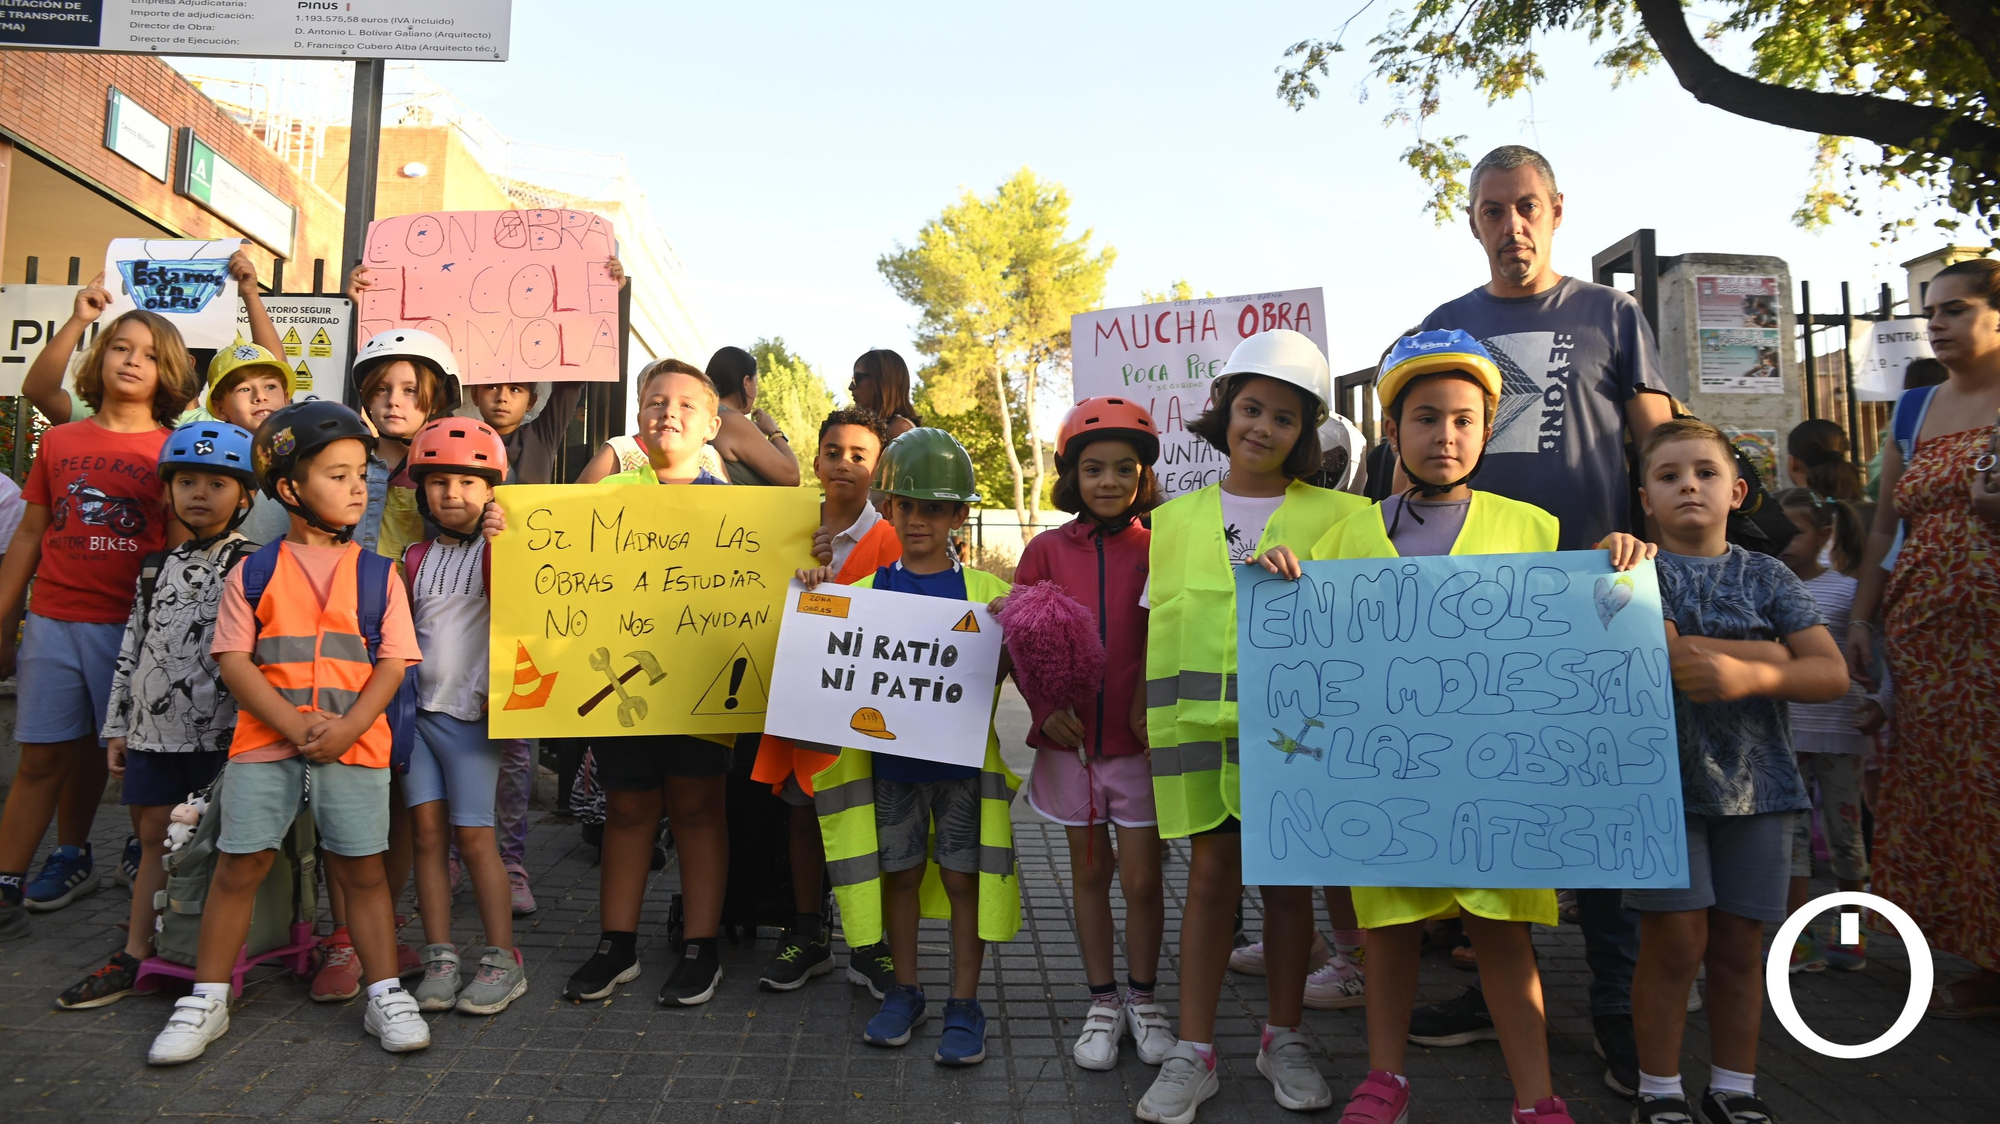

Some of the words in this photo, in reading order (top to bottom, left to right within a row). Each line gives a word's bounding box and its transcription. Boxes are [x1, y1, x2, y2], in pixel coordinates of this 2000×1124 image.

[0, 0, 62, 9] ILITACIÓN
[130, 9, 170, 17] Importe
[187, 11, 255, 19] adjudicación:
[8, 11, 93, 23] TRANSPORTE,
[129, 22, 170, 30] Director
[295, 15, 359, 23] 1.193.575,58
[390, 17, 410, 25] (IVA
[412, 18, 454, 26] incluido)
[129, 35, 170, 43] Director
[188, 37, 240, 45] Ejecución:
[307, 28, 346, 36] Antonio
[434, 31, 491, 39] (Arquitecto)
[395, 43, 417, 51] Alba
[419, 44, 473, 52] (Arquitecto
[475, 45, 497, 53] téc.)
[368, 213, 477, 263] CON
[494, 208, 612, 256] OBRA
[134, 261, 223, 287] Estamos
[156, 284, 184, 297] en
[361, 265, 432, 321] EL
[469, 262, 618, 319] COLE
[144, 296, 201, 309] obras
[240, 306, 299, 314] OATORIO
[300, 307, 332, 315] SEGUIR
[1198, 298, 1221, 306] PABLO
[289, 316, 340, 325] SEGURIDAD
[1095, 309, 1218, 357] MUCHA
[1237, 302, 1312, 338] OBRA
[466, 318, 618, 383] MOLA
[1122, 363, 1169, 386] POCA
[1186, 354, 1228, 380] PRE
[1538, 331, 1574, 454] BEYOND
[1163, 440, 1231, 466] UNTA
[53, 456, 107, 478] SPEED
[110, 458, 154, 486] RACE
[590, 506, 690, 554] MADRUGA
[715, 514, 761, 553] LAS
[89, 536, 138, 552] BIKES
[535, 563, 614, 595] OBRAS
[633, 570, 649, 592] A
[803, 605, 832, 613] OBRAS
[809, 594, 832, 603] ZONA
[1248, 573, 1335, 649] EN
[1427, 565, 1572, 641] COLE
[545, 605, 588, 639] NO
[619, 611, 655, 636] NOS
[675, 604, 773, 636] AYUDAN.
[1266, 659, 1364, 719] ME
[1386, 647, 1671, 720] MOLESTAN
[1327, 725, 1454, 780] LAS
[1466, 725, 1669, 787] OBRAS
[1268, 788, 1438, 865] NOS
[1449, 793, 1679, 880] AFECTAN
